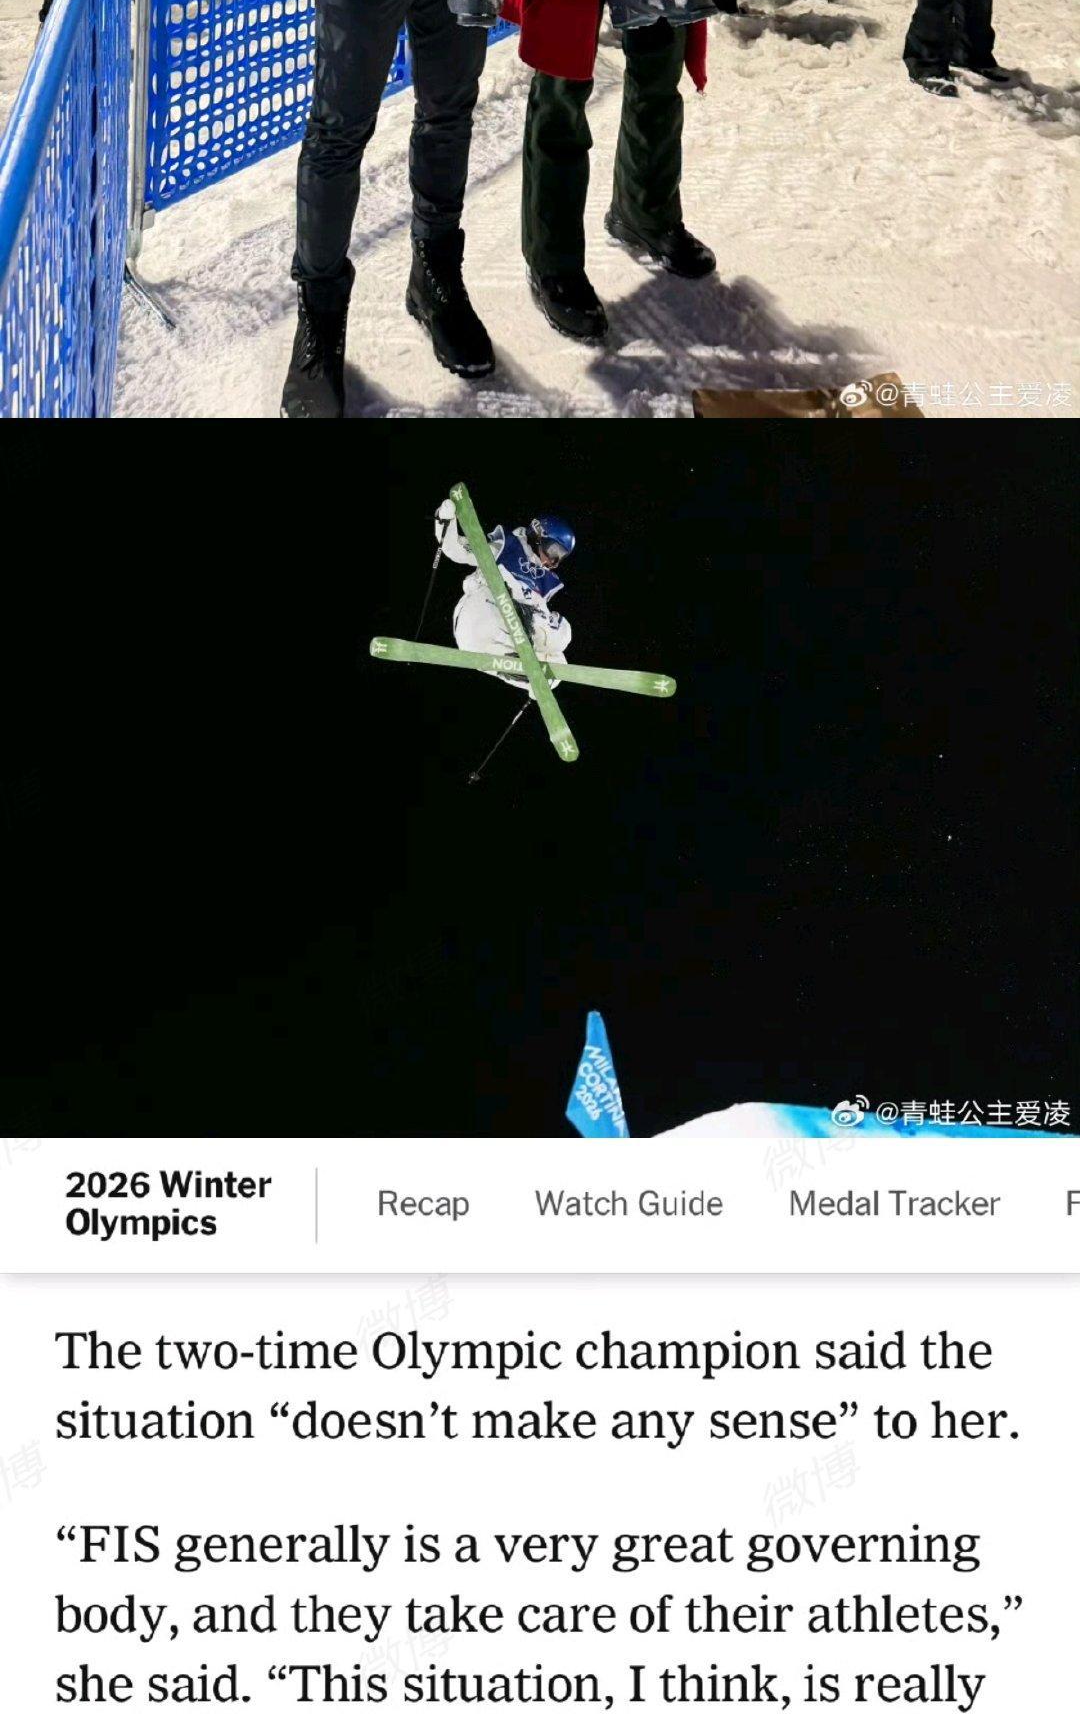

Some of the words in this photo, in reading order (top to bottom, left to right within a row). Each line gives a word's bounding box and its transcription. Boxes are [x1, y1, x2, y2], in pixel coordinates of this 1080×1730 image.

[497, 594, 526, 646] FACTION
[575, 1084, 602, 1121] 2026
[65, 1171, 151, 1199] 2026
[159, 1170, 272, 1199] Winter
[378, 1190, 470, 1222] Recap
[535, 1189, 628, 1216] Watch
[638, 1189, 723, 1217] Guide
[790, 1190, 879, 1217] Medal
[888, 1190, 1001, 1217] Tracker
[65, 1207, 217, 1242] Olympics
[54, 1330, 142, 1370] The
[155, 1330, 358, 1370] two-time
[372, 1330, 562, 1380] Olympic
[576, 1330, 801, 1380] champion
[815, 1330, 907, 1370] said
[920, 1330, 992, 1370] the
[56, 1400, 255, 1440] situation
[472, 1400, 597, 1440] make
[611, 1410, 695, 1450] any
[873, 1405, 918, 1440] to
[931, 1400, 1019, 1440] her.
[174, 1524, 391, 1573] generally
[404, 1524, 441, 1563] is
[454, 1534, 481, 1563] a
[494, 1534, 599, 1573] very
[612, 1528, 734, 1573] great
[746, 1524, 981, 1573] governing
[54, 1594, 179, 1643] body,
[193, 1594, 277, 1634] and
[290, 1594, 392, 1643] they
[405, 1594, 504, 1634] take
[518, 1604, 616, 1634] care
[629, 1594, 674, 1634] of
[684, 1594, 794, 1634] their
